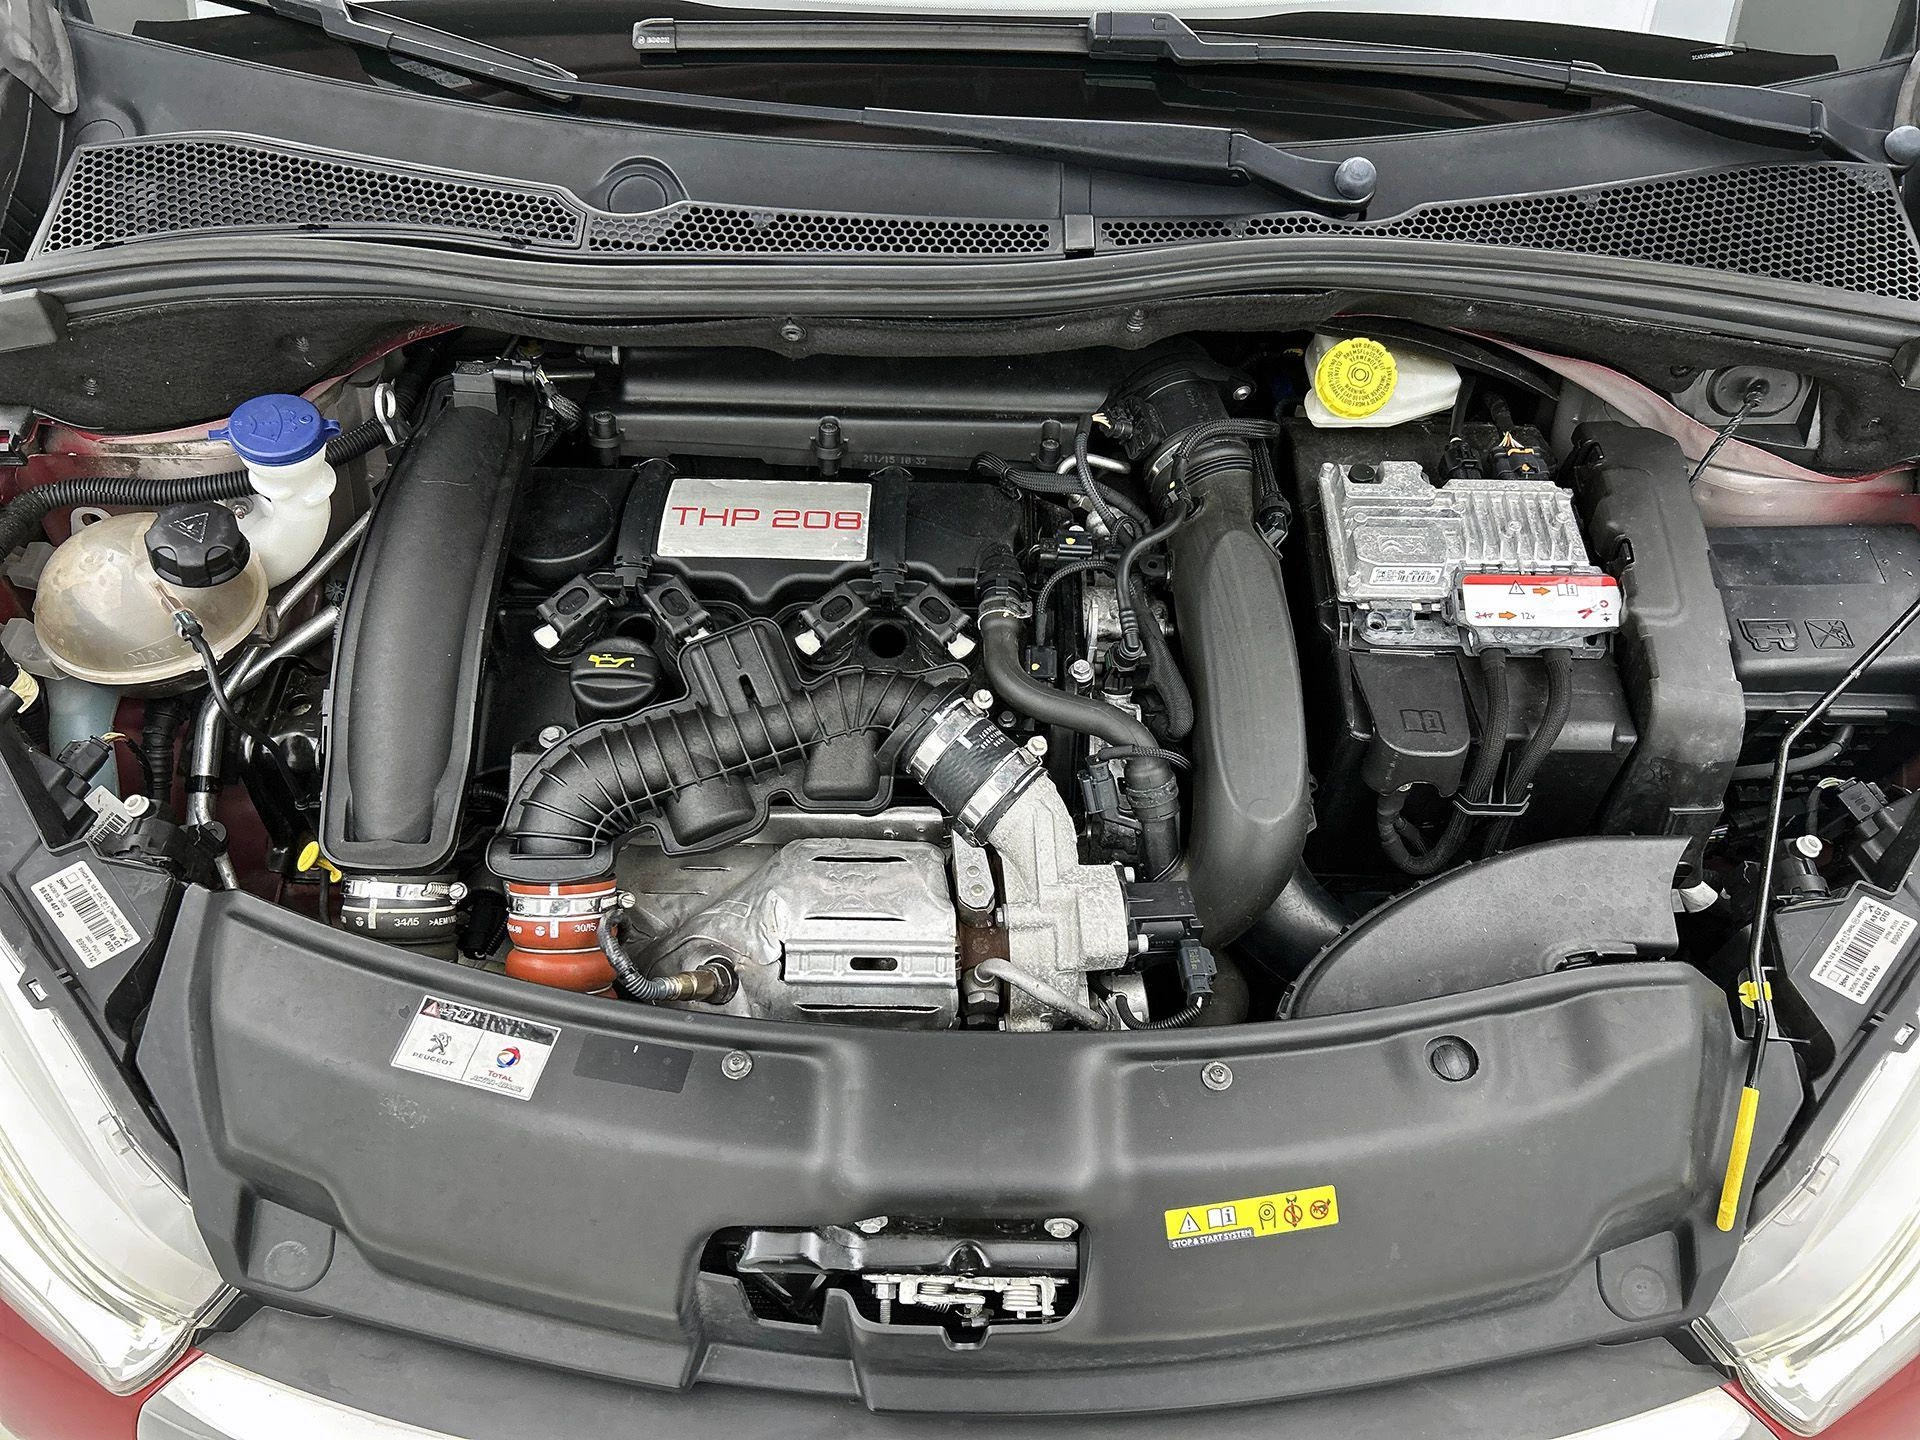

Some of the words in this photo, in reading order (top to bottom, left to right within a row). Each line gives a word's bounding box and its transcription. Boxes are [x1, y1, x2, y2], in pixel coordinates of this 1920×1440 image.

[672, 507, 760, 527] THP
[772, 510, 862, 530] 208
[1521, 612, 1536, 620] 12v
[1875, 907, 1883, 916] GT
[394, 917, 420, 926] 34/15
[574, 923, 596, 932] 30/15
[114, 940, 122, 949] GT
[412, 1052, 454, 1066] PEUGEOT
[488, 1070, 512, 1082] TOTAL
[1173, 1239, 1193, 1247] STOP
[1200, 1234, 1223, 1243] START
[1223, 1229, 1252, 1240] SYSTEM
